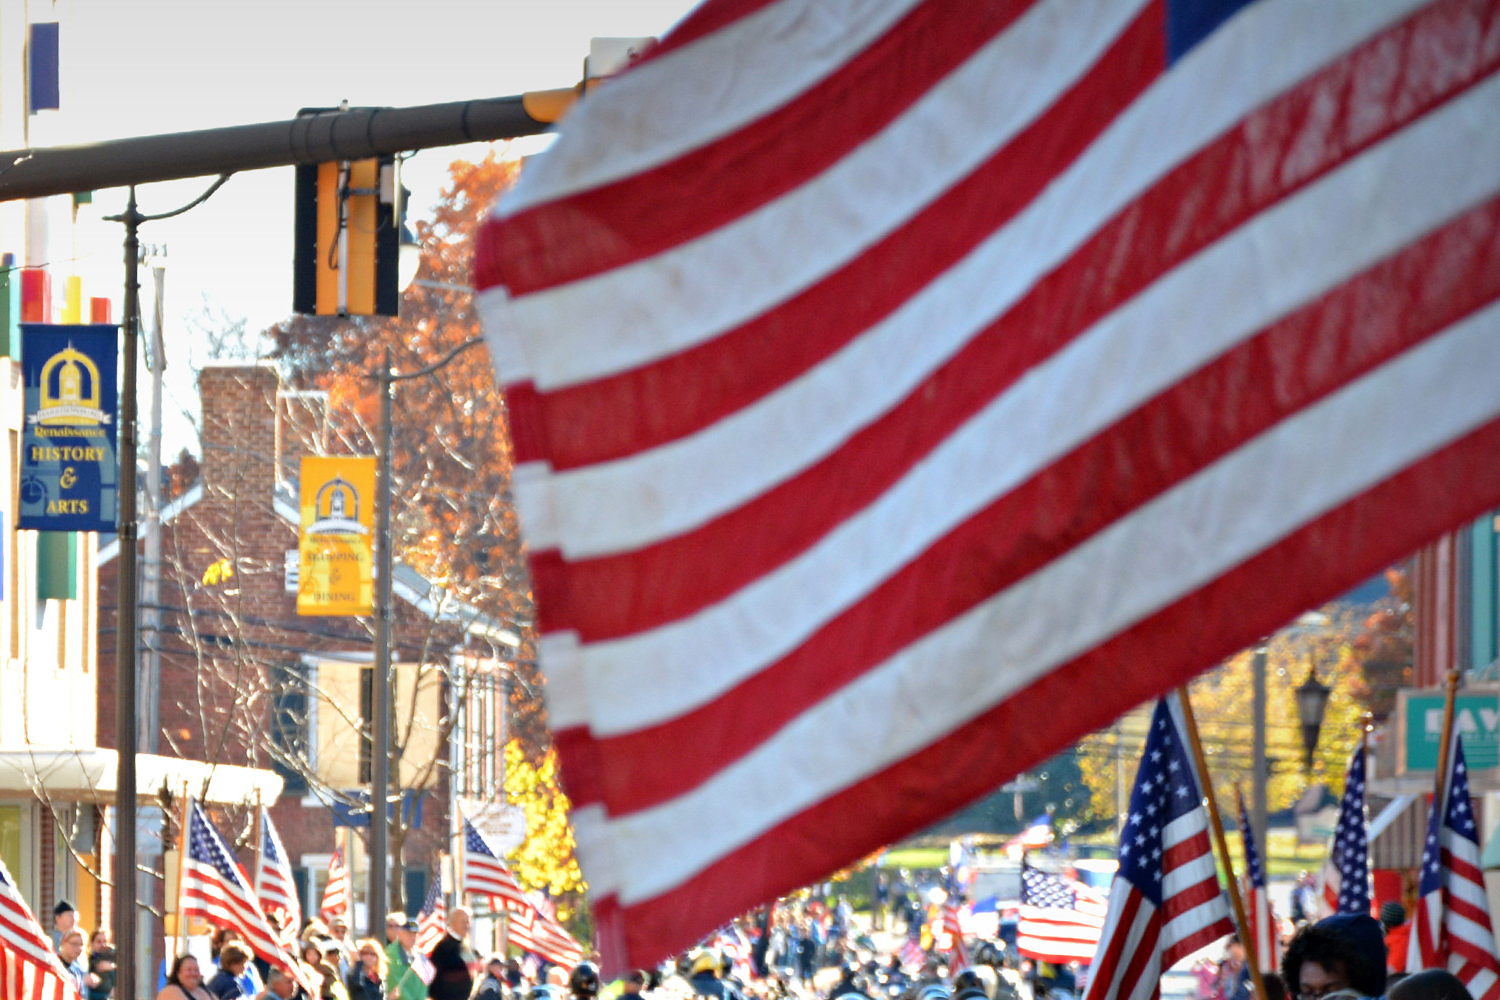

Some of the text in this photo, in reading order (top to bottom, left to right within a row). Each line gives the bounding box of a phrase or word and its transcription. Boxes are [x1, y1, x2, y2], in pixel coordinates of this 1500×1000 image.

[31, 446, 106, 461] HISTORY
[60, 466, 78, 489] &
[46, 499, 89, 514] ARTS
